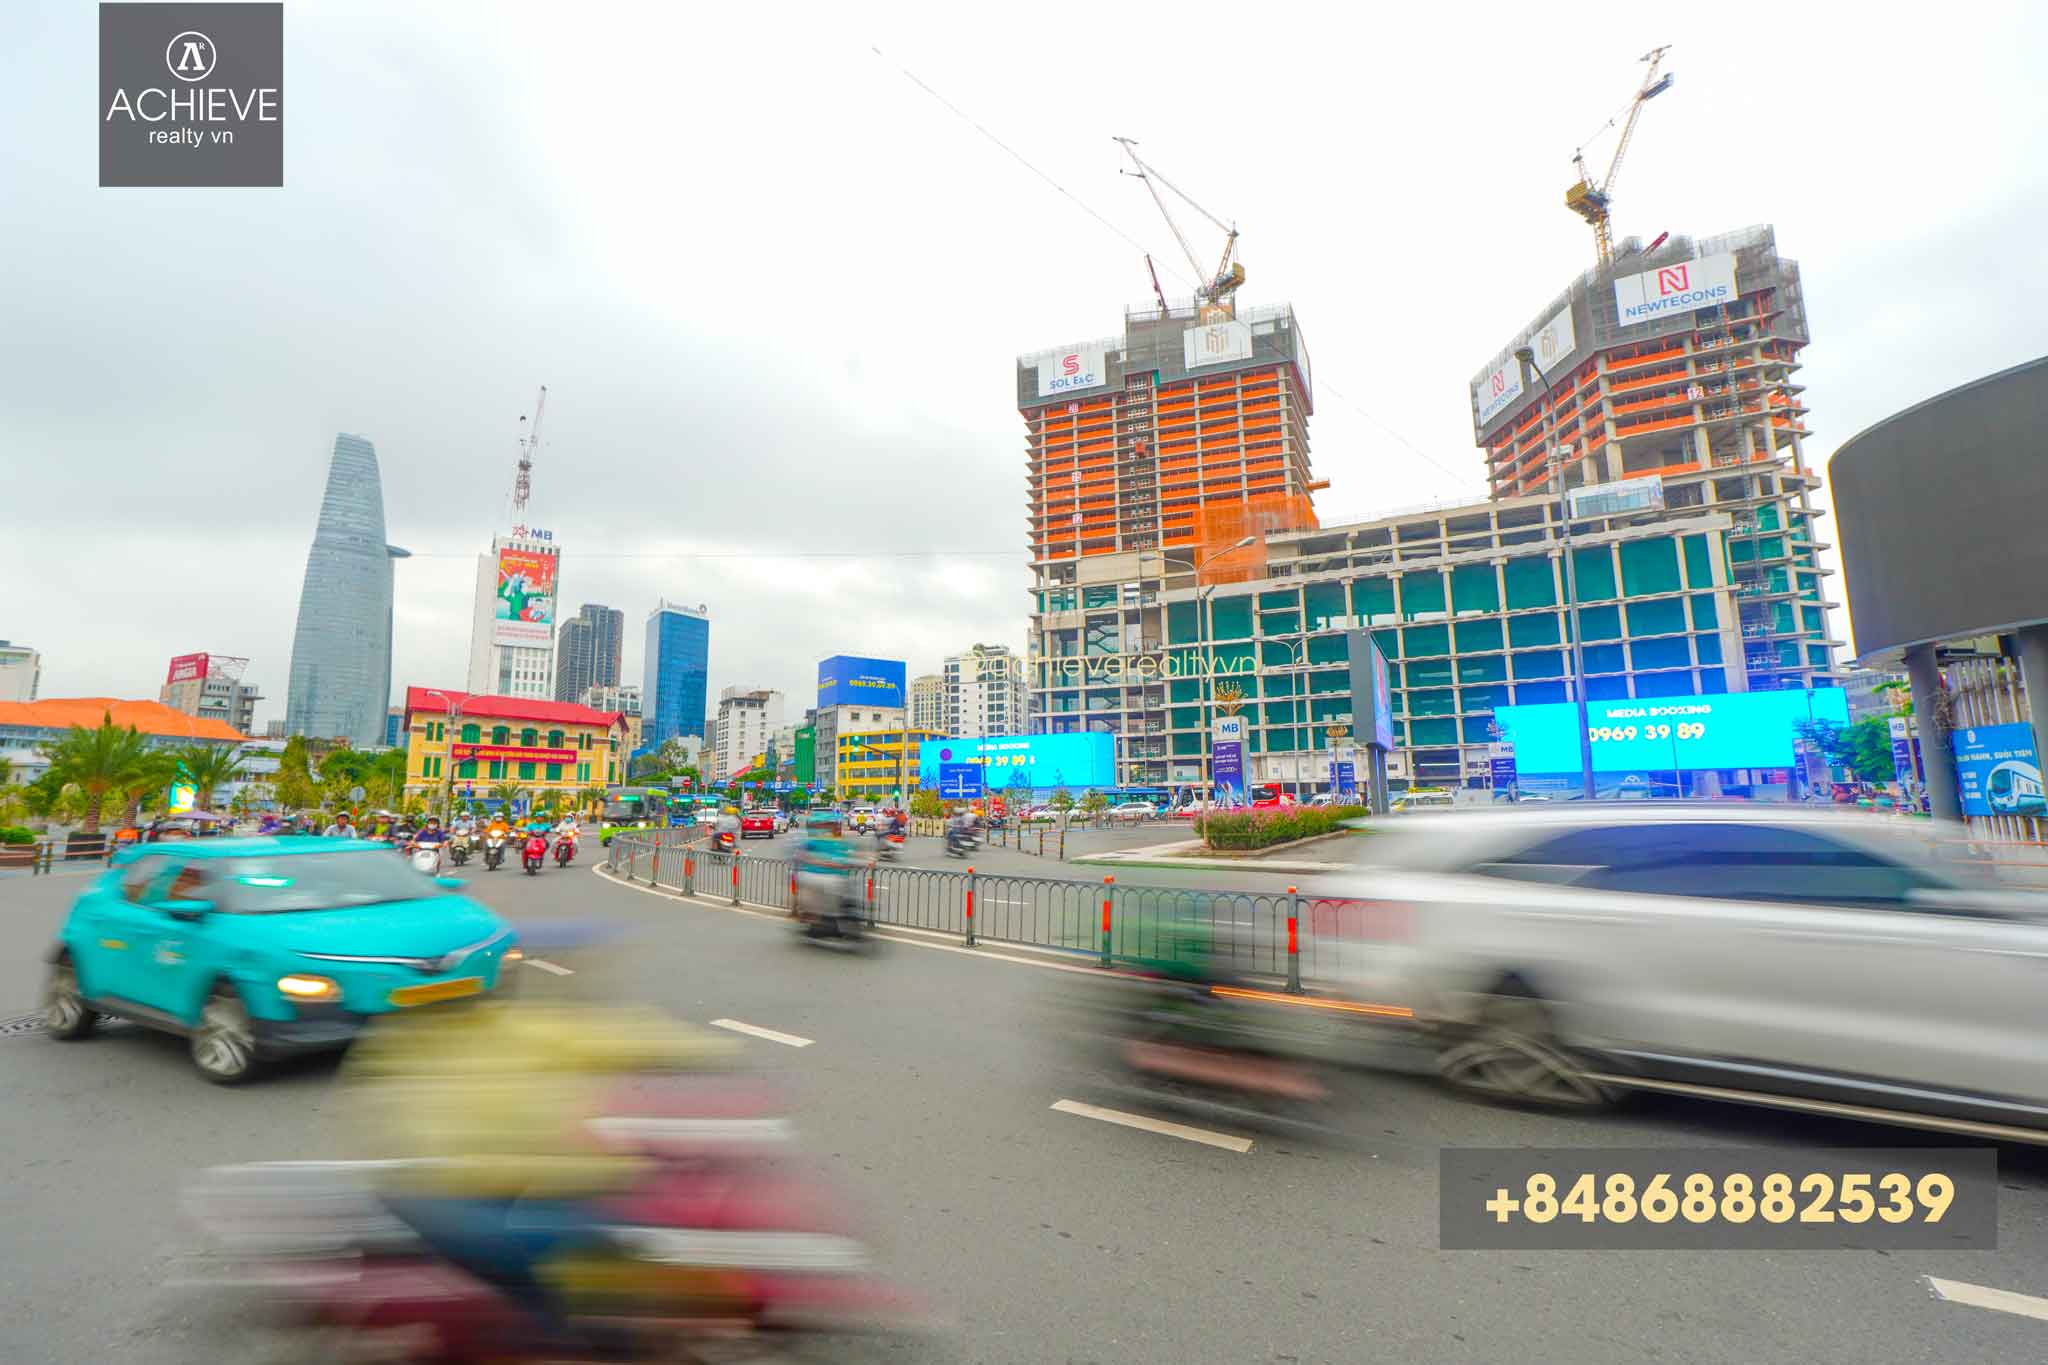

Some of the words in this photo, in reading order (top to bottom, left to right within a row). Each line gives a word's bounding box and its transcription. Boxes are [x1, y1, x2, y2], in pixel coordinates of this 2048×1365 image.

[1625, 285, 1728, 317] NEWTECONS
[1049, 378, 1070, 389] SOL
[531, 528, 552, 540] MB
[1606, 708, 1647, 718] MEDIA
[1222, 723, 1239, 733] MB
[1588, 725, 1637, 742] 0969
[1644, 724, 1671, 739] 39
[1677, 722, 1705, 740] 89
